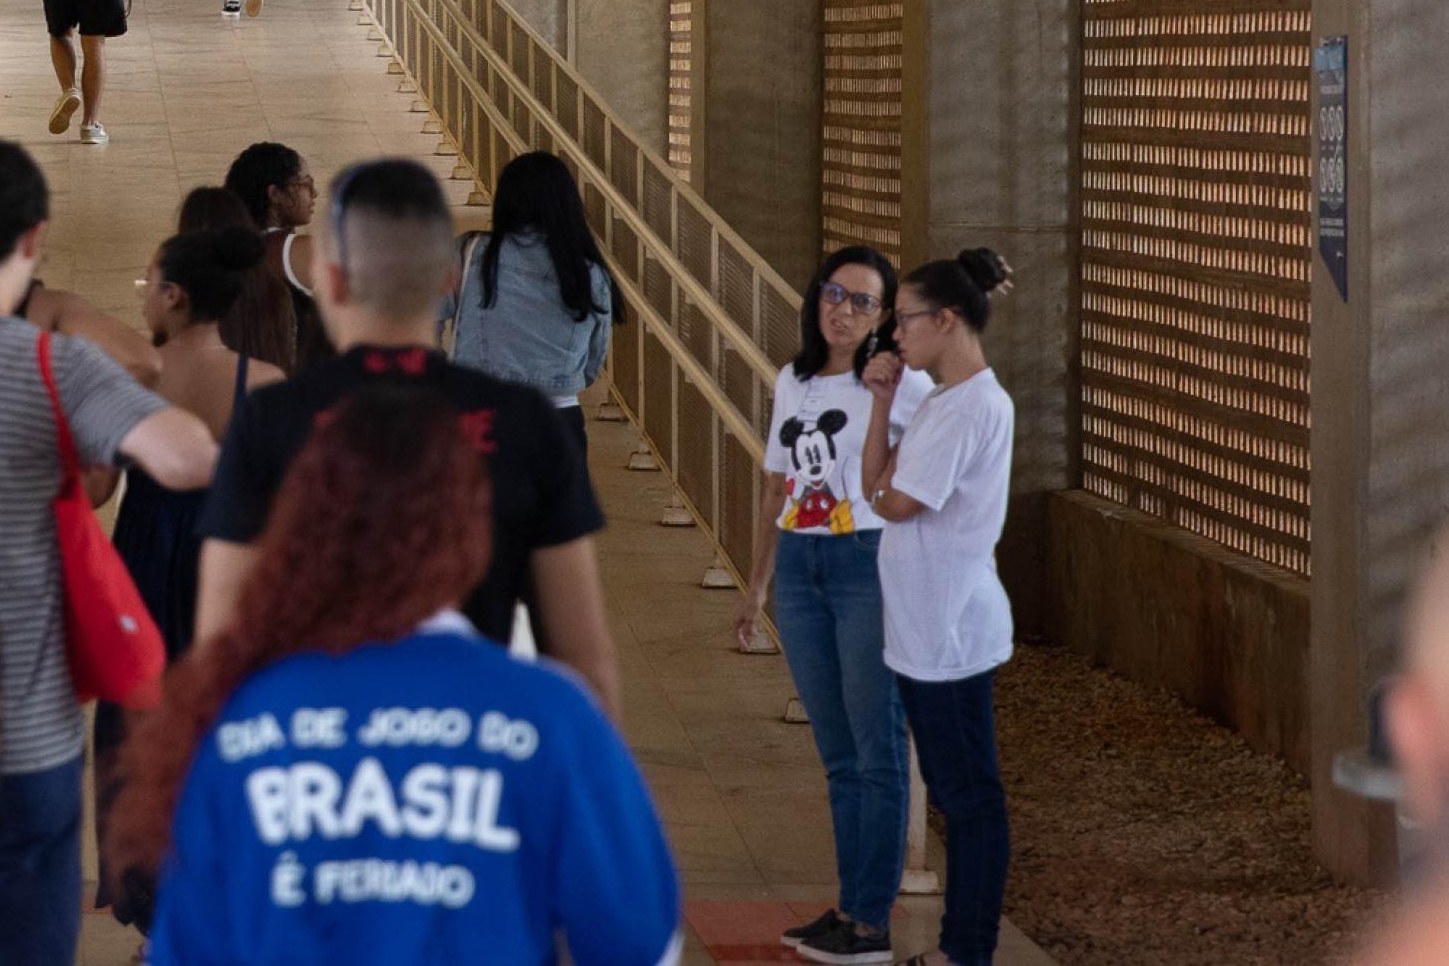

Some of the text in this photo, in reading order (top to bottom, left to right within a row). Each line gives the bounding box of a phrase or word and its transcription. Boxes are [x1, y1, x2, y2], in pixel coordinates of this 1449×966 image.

[218, 707, 538, 761] DIA DE JOGO DO
[247, 757, 520, 851] BRASIL
[272, 851, 304, 906] É
